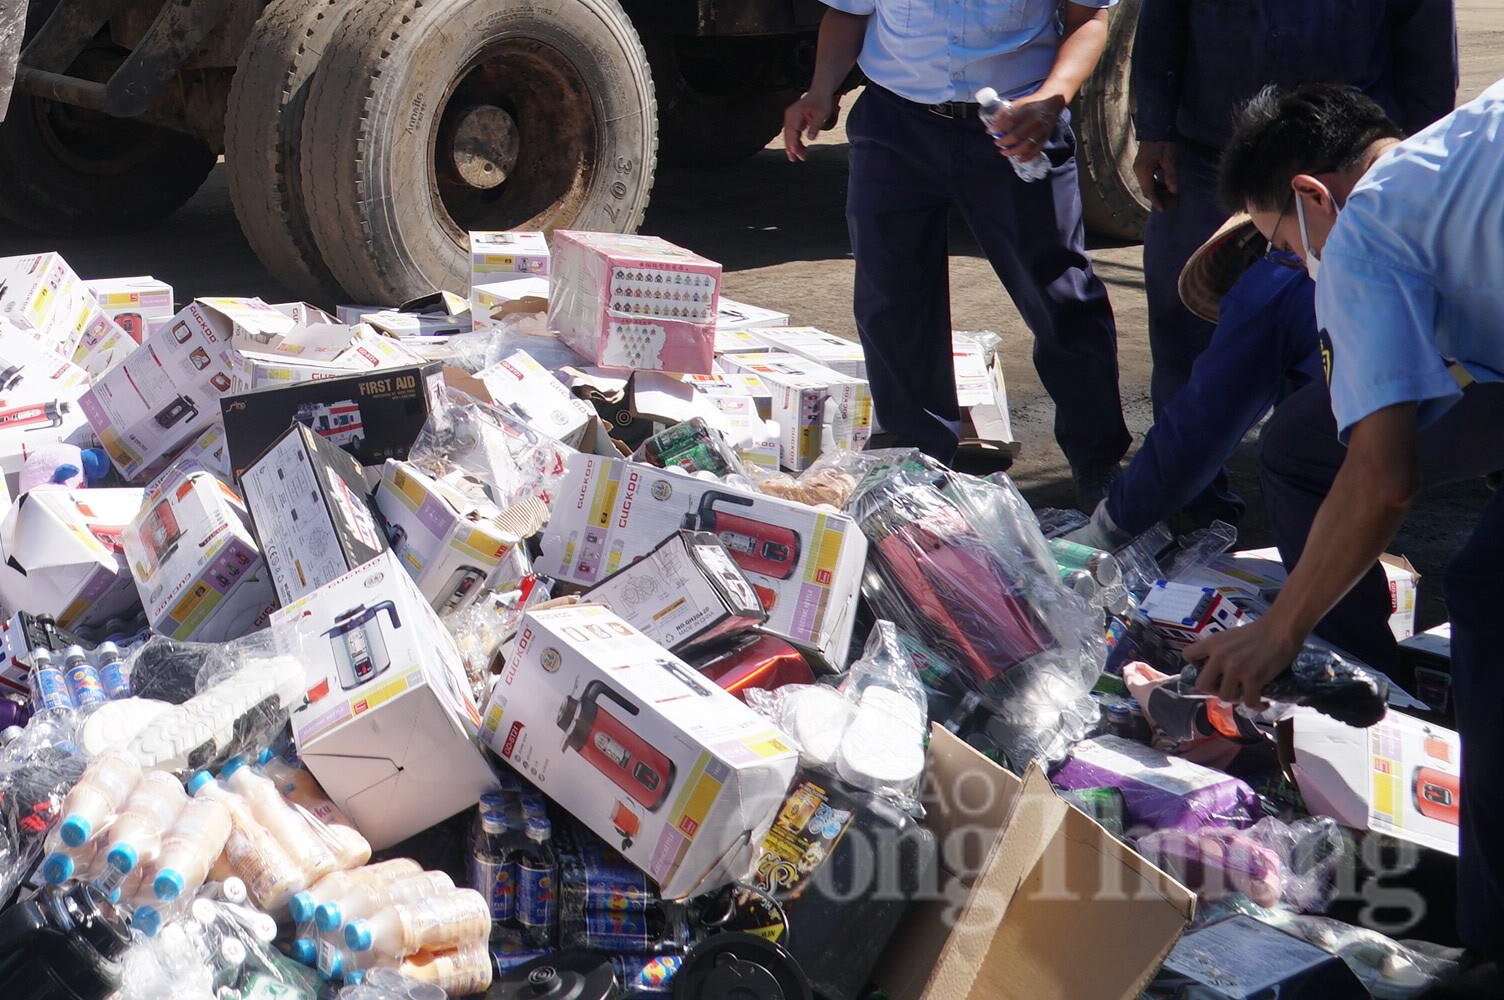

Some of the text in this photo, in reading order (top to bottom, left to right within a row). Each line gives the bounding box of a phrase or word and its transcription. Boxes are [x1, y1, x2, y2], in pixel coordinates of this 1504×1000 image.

[189, 305, 219, 344] CUCKOO
[359, 378, 393, 397] FIRST
[396, 375, 416, 390] AID
[577, 459, 595, 510] CUCKOO
[618, 471, 639, 529] CUCKOO
[154, 572, 192, 618] CUCKOO
[328, 557, 382, 589] CUCKOO
[505, 627, 532, 686] CUCKOO
